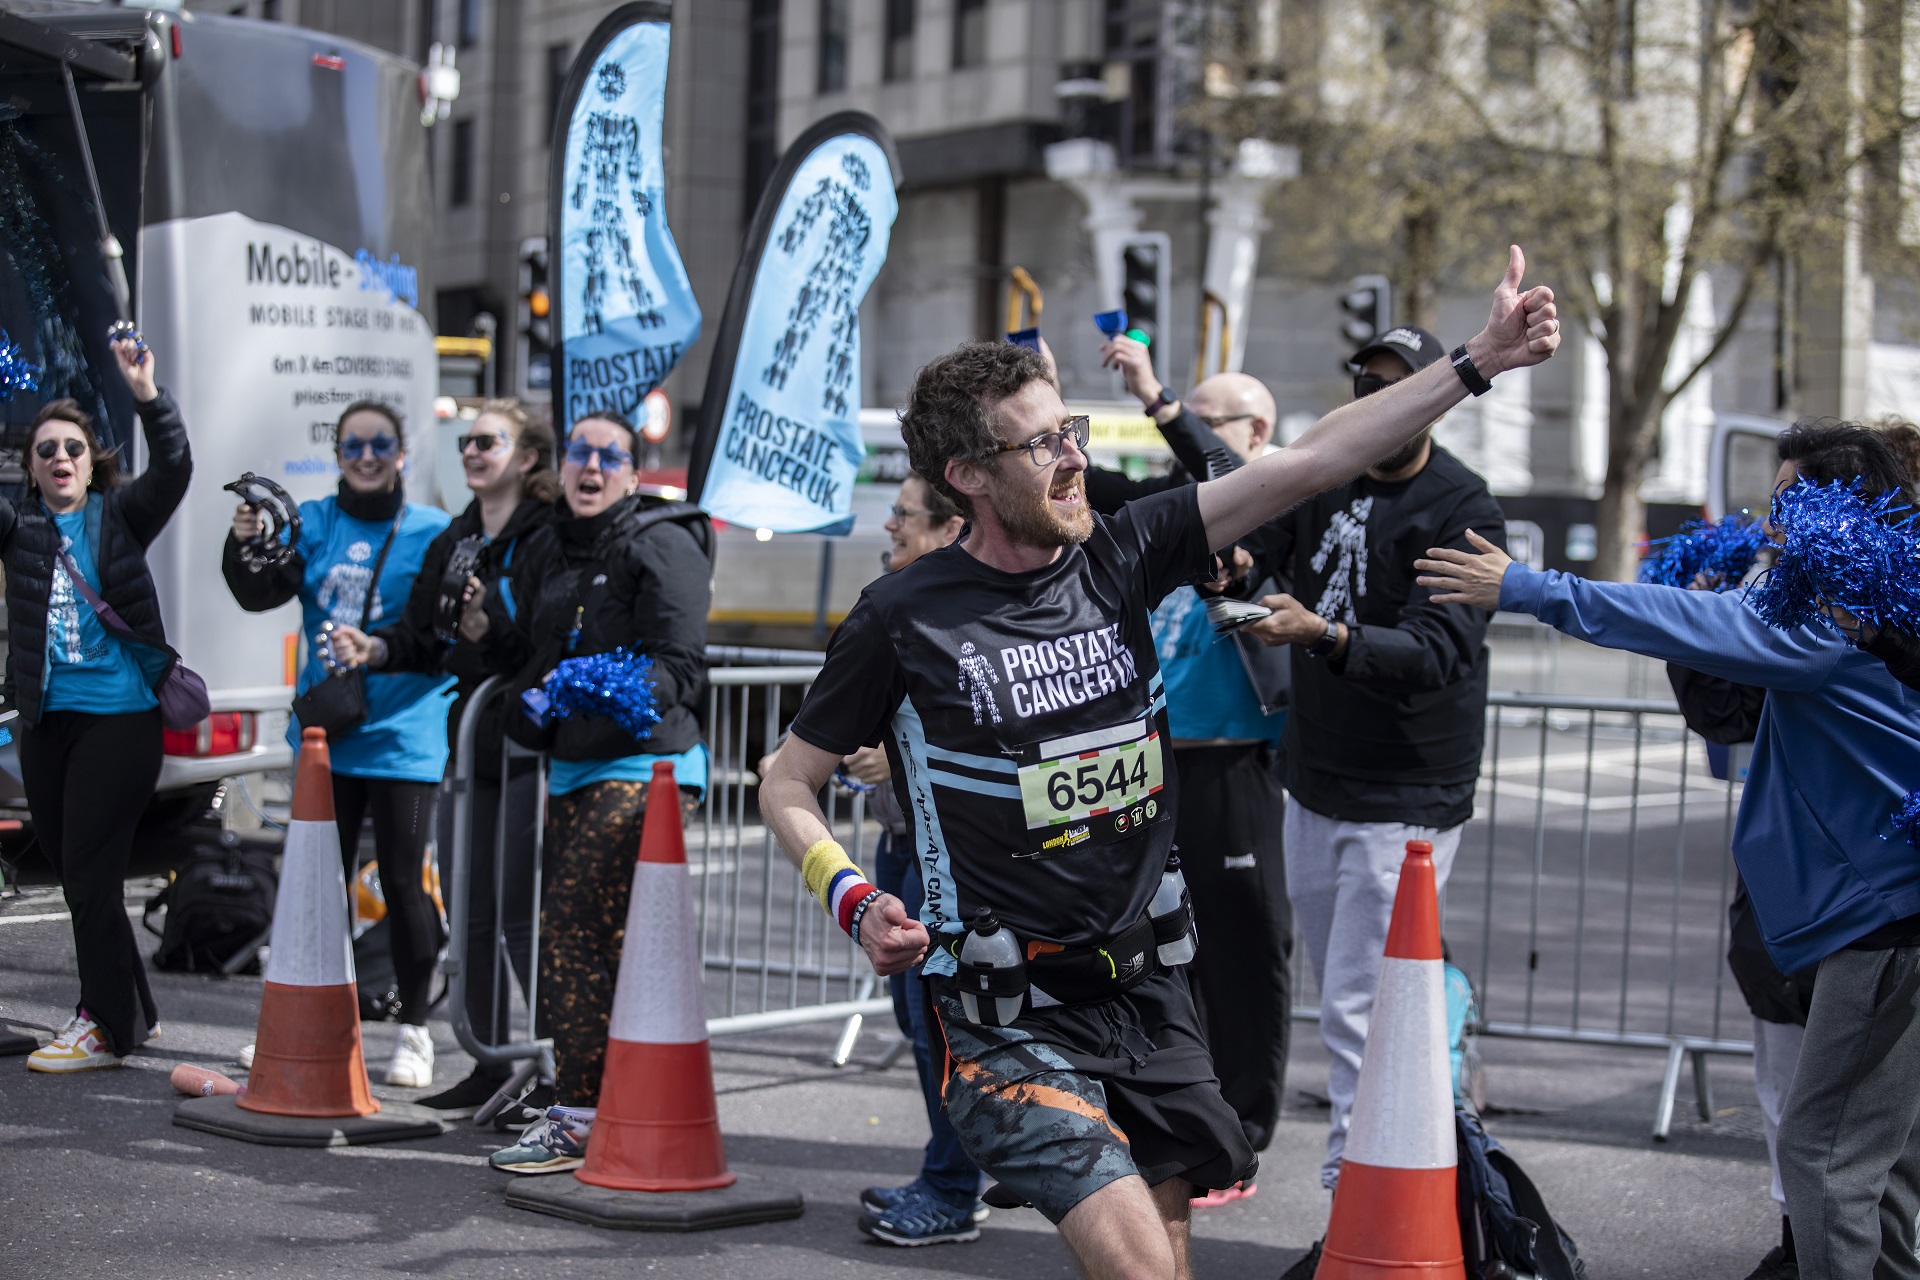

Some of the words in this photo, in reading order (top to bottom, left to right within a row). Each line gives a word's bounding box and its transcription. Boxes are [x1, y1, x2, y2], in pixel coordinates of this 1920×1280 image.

[247, 241, 341, 290] Mobile
[250, 302, 317, 328] MOBILE
[570, 341, 681, 390] PROSTATE
[735, 390, 840, 475] PROSTATE
[725, 427, 807, 494] CANCER
[807, 472, 841, 513] UK
[1000, 623, 1126, 683] PROSTATE
[1011, 664, 1116, 719] CANCER
[1047, 750, 1149, 811] 6544
[1042, 835, 1065, 850] LONDON
